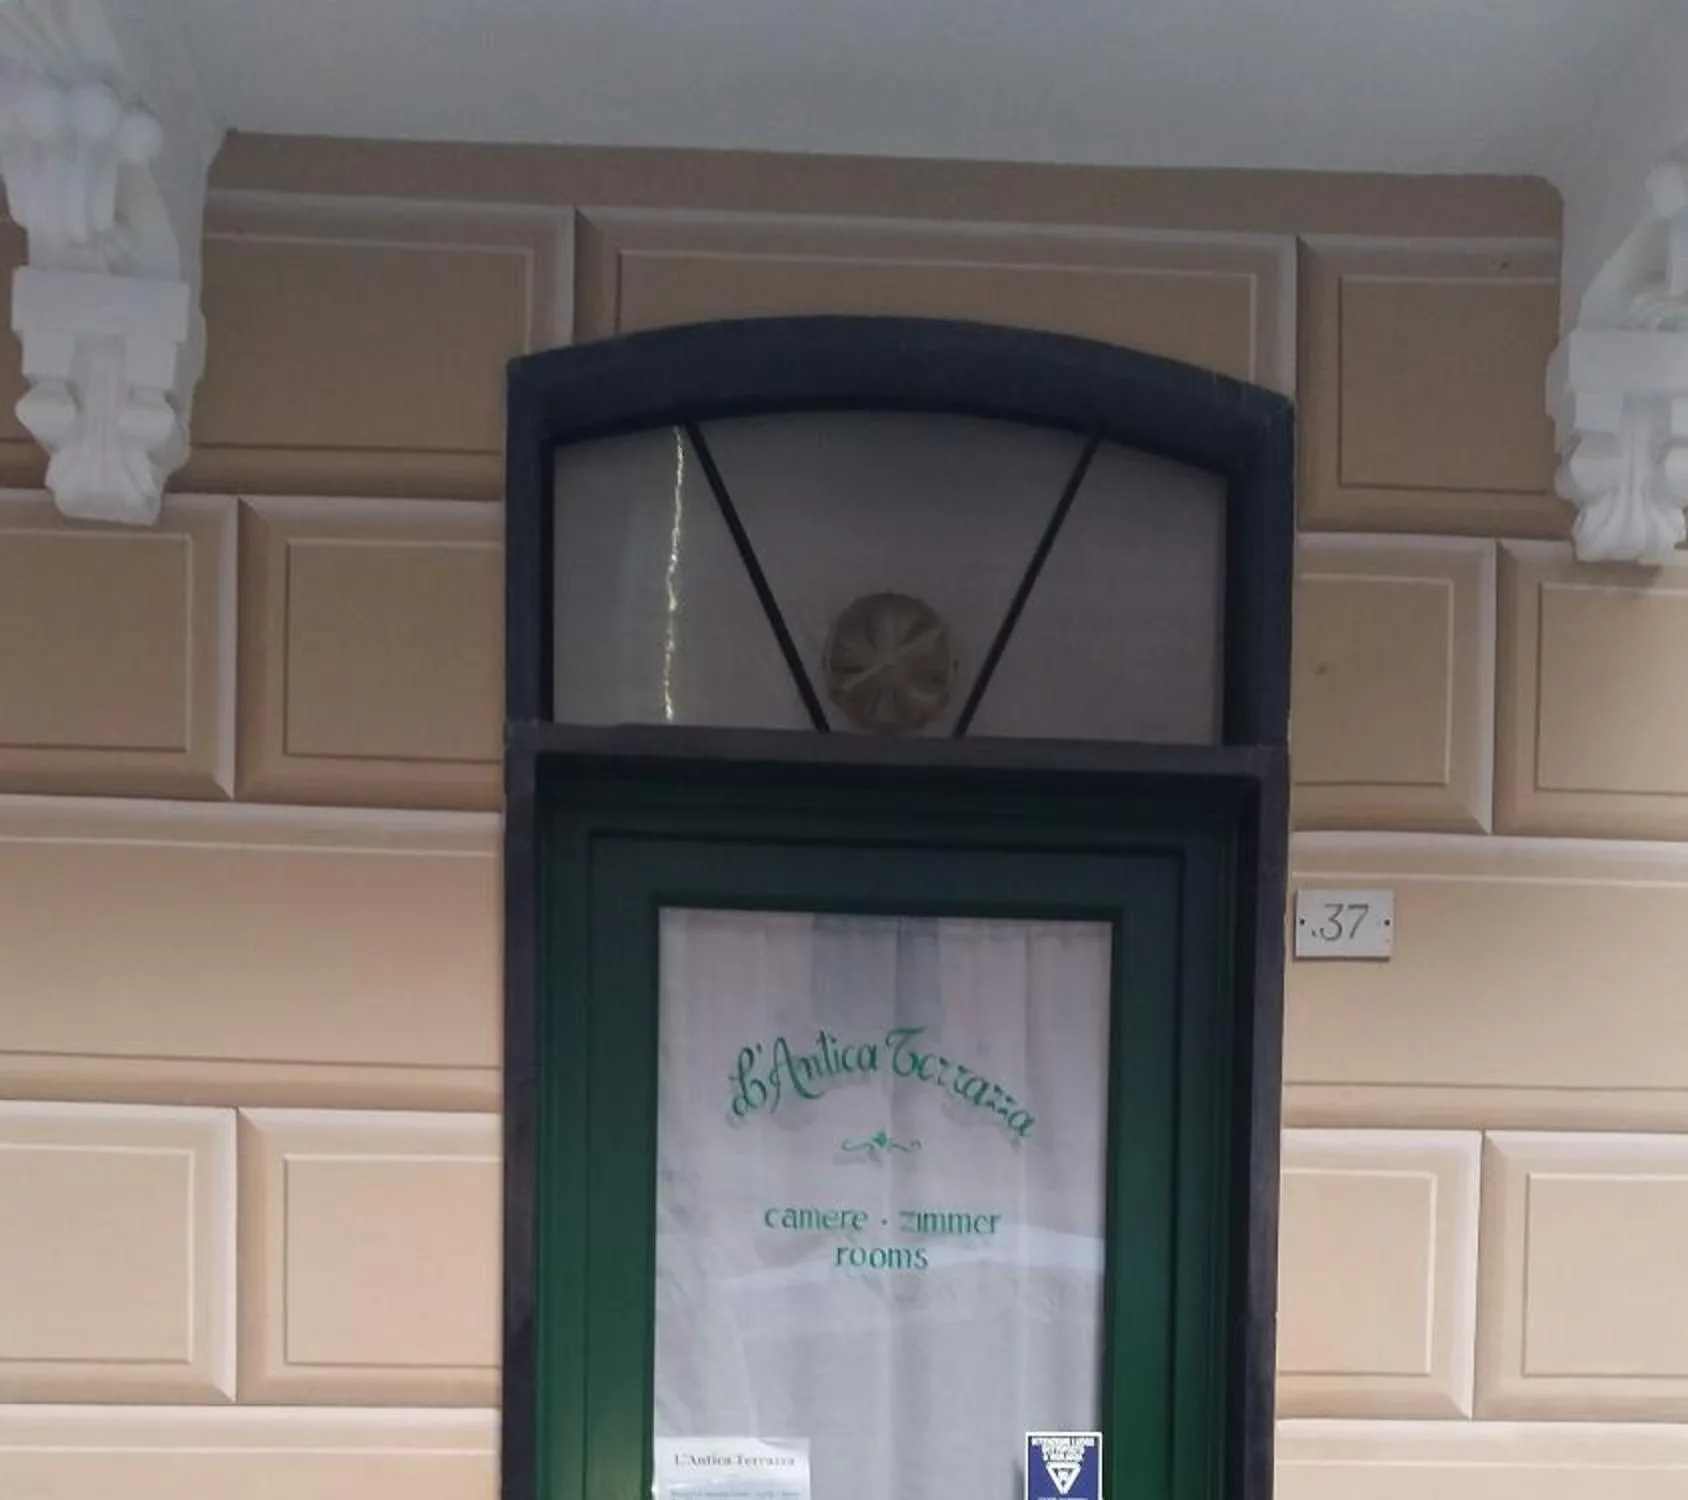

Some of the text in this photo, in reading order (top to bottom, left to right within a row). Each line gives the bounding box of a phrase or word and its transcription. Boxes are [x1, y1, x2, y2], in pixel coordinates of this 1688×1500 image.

[729, 1026, 1036, 1138] L'Antica Terrazza
[763, 1206, 1003, 1236] camere zimmer
[833, 1244, 930, 1270] rooms
